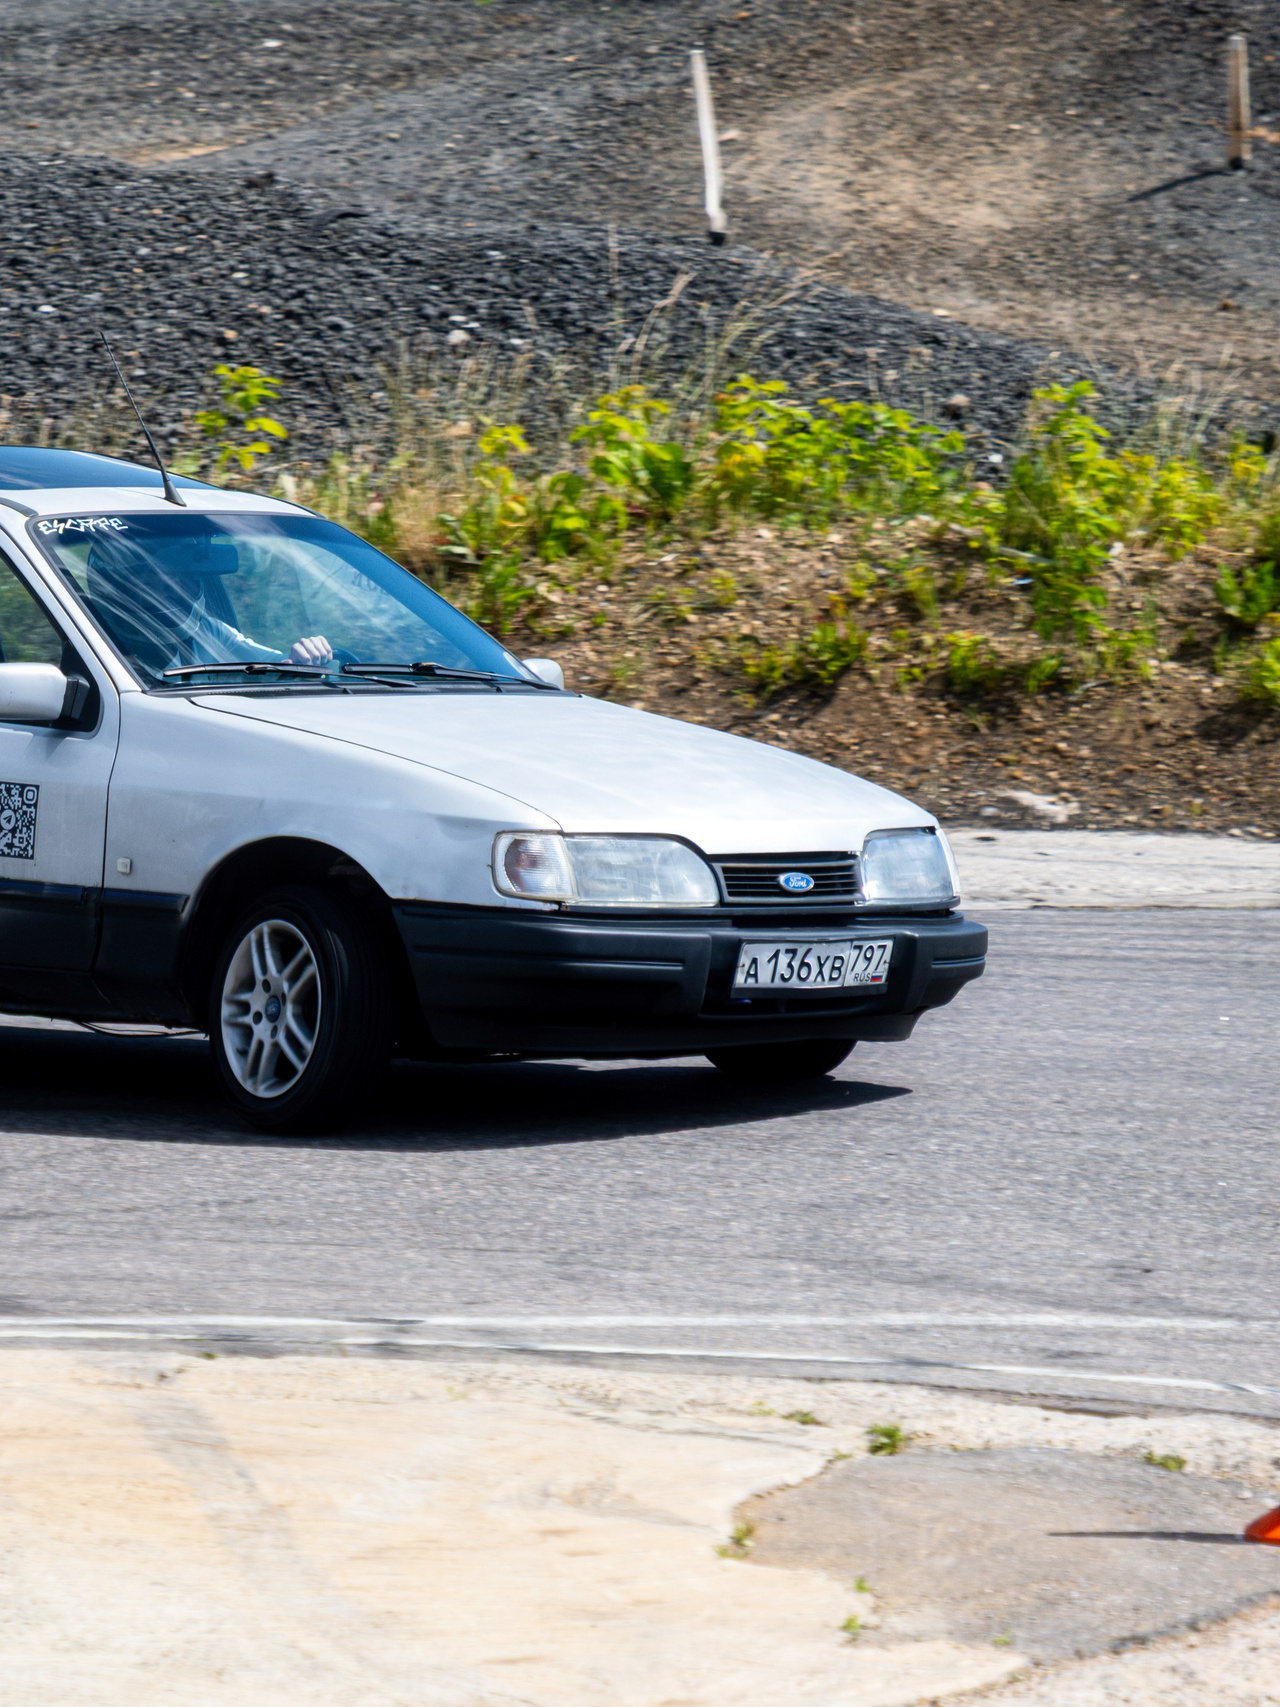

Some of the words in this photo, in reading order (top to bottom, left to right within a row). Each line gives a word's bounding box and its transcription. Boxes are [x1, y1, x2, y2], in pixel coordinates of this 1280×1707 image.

[789, 876, 807, 888] Ford
[850, 944, 888, 972] 797
[853, 972, 871, 983] RUS
